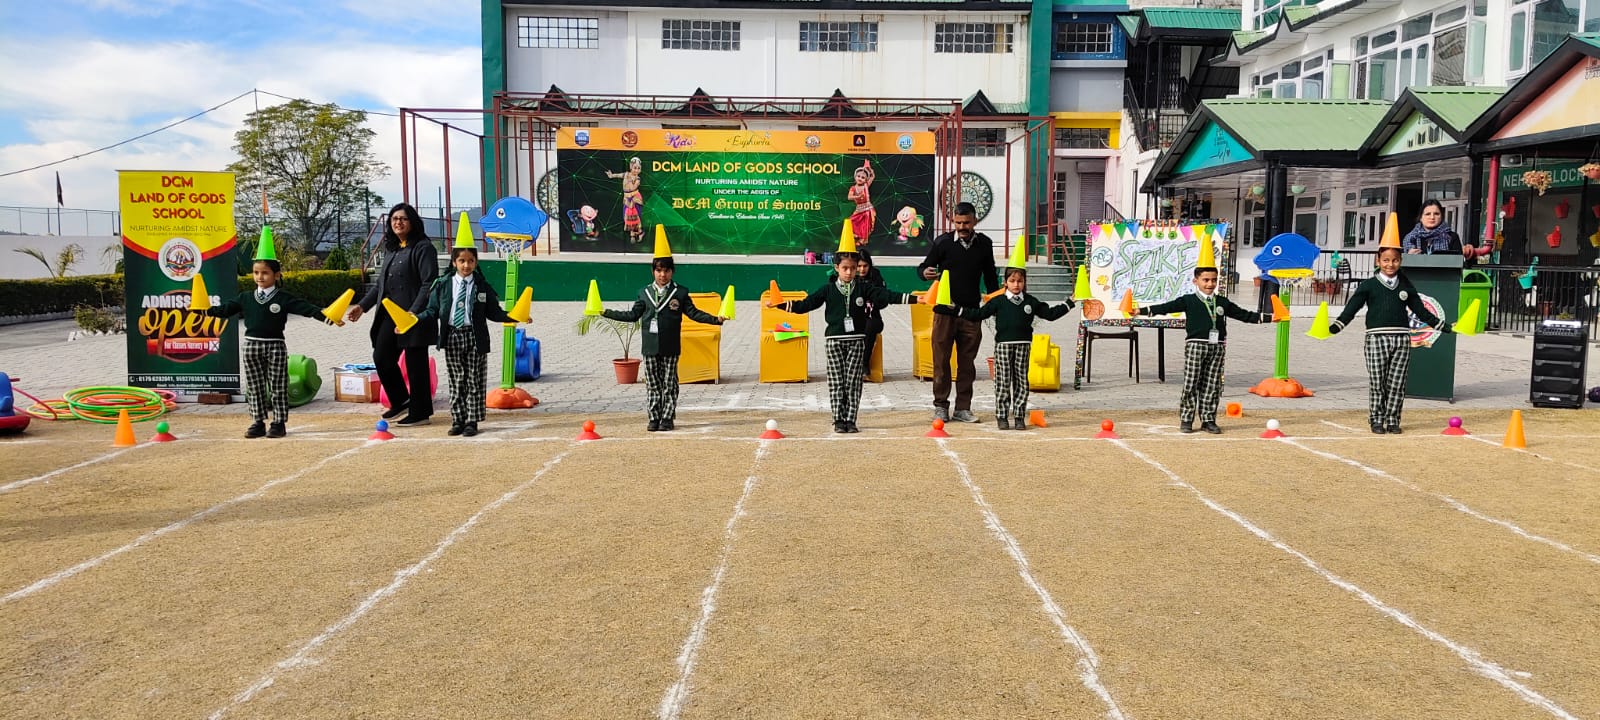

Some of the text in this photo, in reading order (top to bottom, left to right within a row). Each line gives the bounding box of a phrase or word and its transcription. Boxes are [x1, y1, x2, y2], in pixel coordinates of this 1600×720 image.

[652, 161, 841, 174] DCM LAND OF GODS SCHOOL
[161, 176, 193, 187] DCM
[130, 192, 226, 204] LAND OF GODS
[672, 198, 821, 211] DCM Group of Schools
[152, 208, 205, 219] SCHOOL
[200, 225, 228, 233] NATURE
[142, 295, 221, 308] ADMISSS
